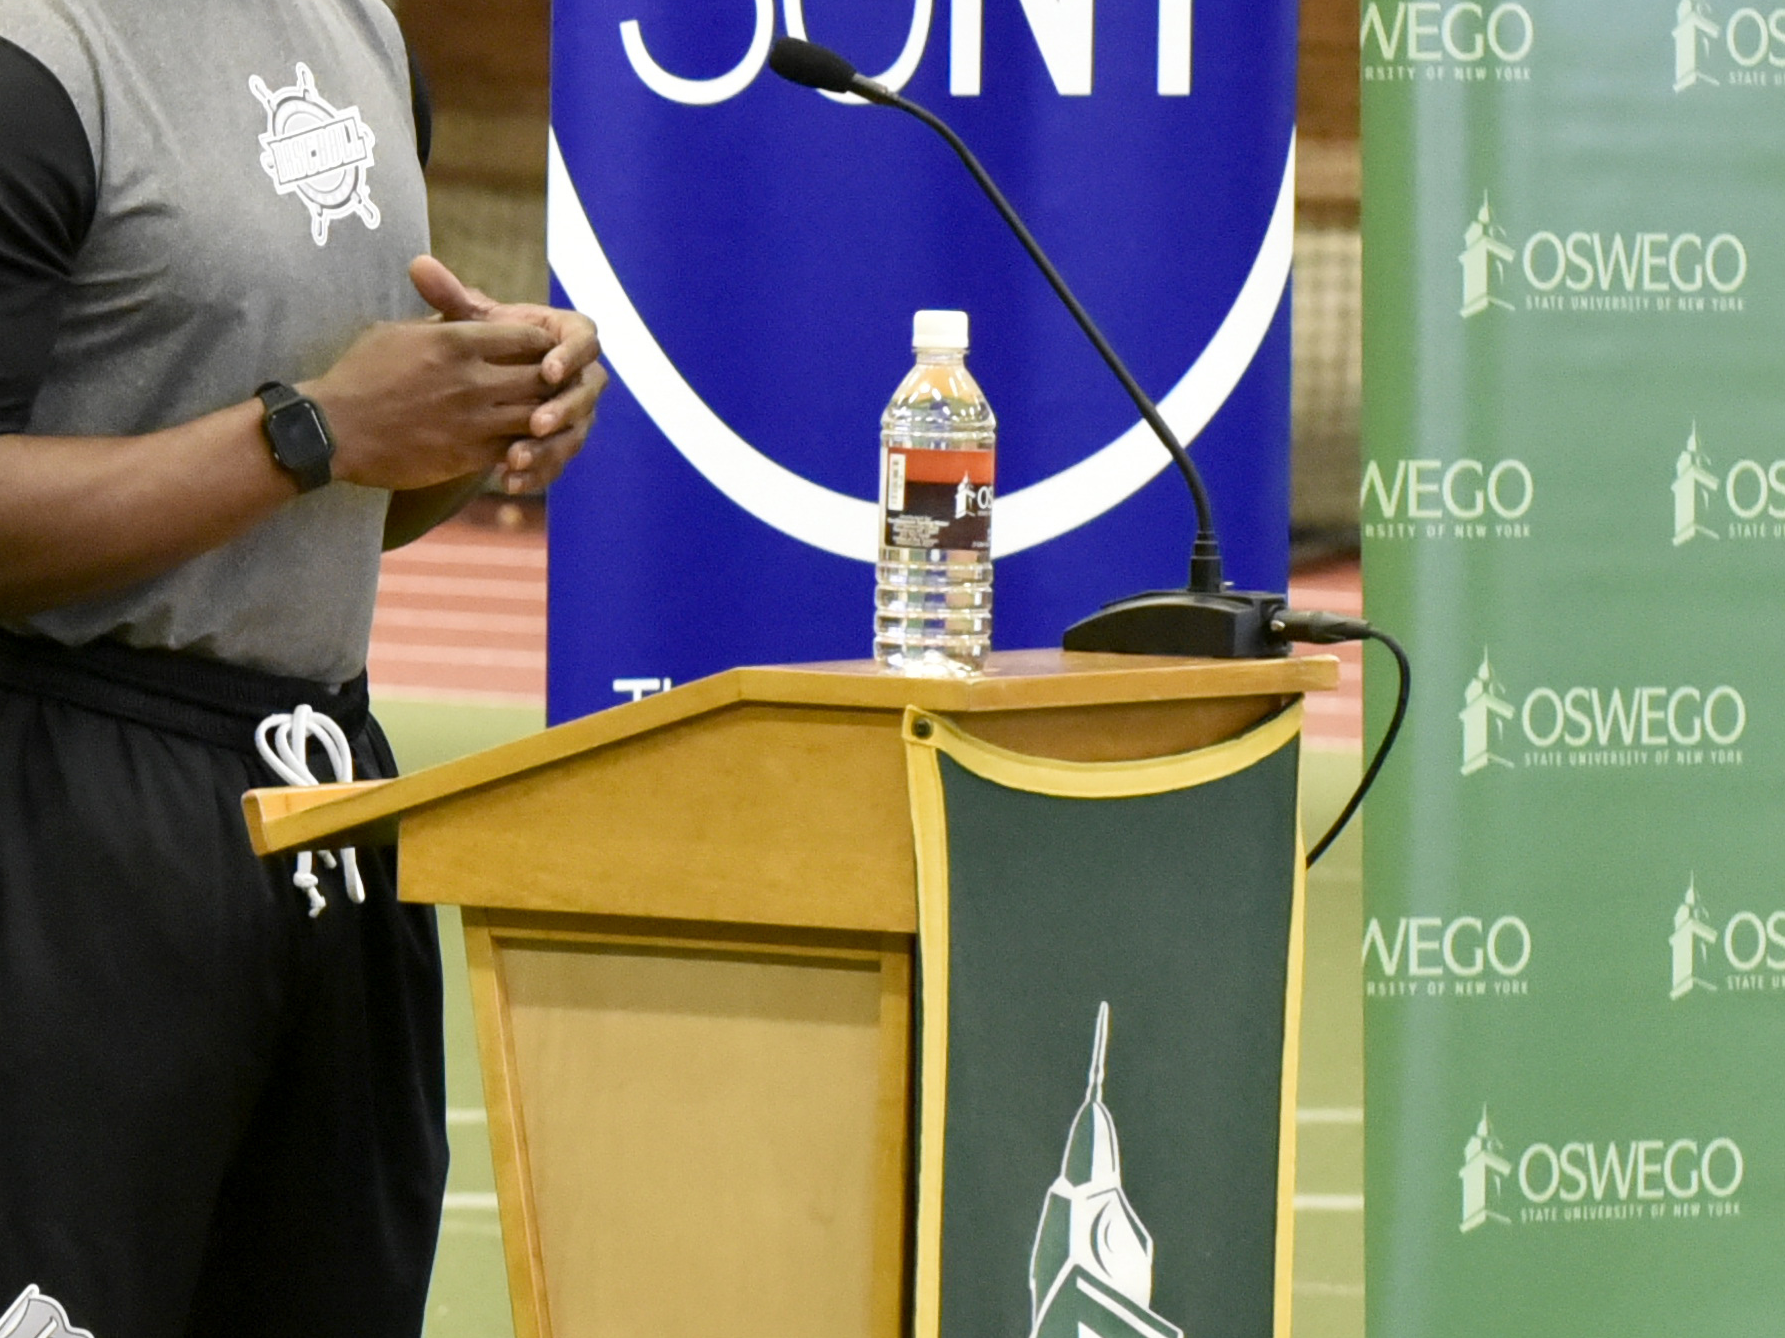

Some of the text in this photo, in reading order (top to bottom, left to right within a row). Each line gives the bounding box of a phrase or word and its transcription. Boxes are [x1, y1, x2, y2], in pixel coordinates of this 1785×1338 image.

[1426, 65, 1443, 81] OF
[1454, 66, 1486, 81] NEW
[1495, 66, 1530, 81] YORK
[1522, 231, 1747, 292] OSWEGO
[1525, 295, 1744, 311] STATE UNIVERSITY OF NEW YORK
[1426, 523, 1443, 538] OF
[1454, 523, 1486, 538] NEW
[1495, 523, 1530, 538] YORK
[1521, 685, 1746, 747] OSWEGO
[1524, 749, 1743, 767] STATE UNIVERSITY OF NEW YORK
[1427, 980, 1444, 996] OF
[1455, 980, 1486, 995] NEW
[1495, 979, 1528, 995] YORK
[1519, 1137, 1744, 1203] OSWEGO
[1521, 1202, 1740, 1223] STATE UNIVERSITY OF NEW YORK
